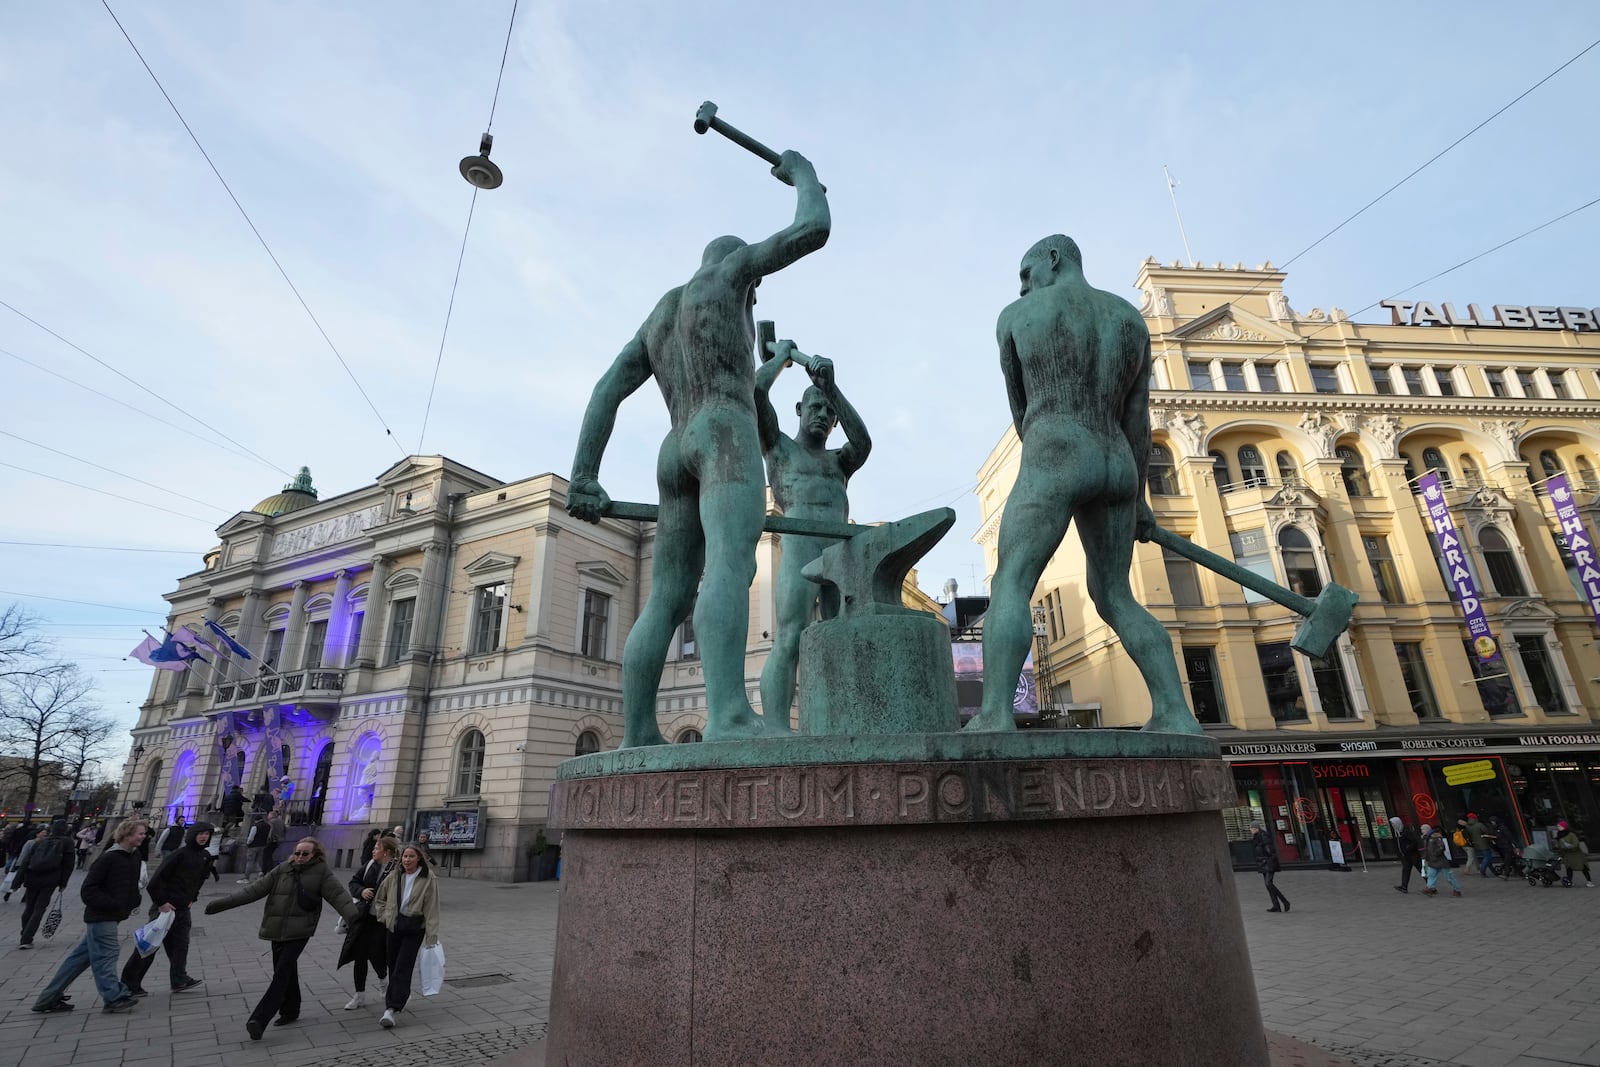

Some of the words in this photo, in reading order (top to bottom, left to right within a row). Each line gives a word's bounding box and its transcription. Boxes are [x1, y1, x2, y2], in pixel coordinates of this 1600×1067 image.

[1380, 300, 1600, 330] TALLBER
[1434, 515, 1479, 615] HARALD
[1340, 741, 1378, 751] SYNSAM
[1401, 737, 1447, 749] ROBERT'S
[1449, 737, 1487, 748] COFFEE
[1519, 736, 1547, 746] KIILA
[1230, 744, 1268, 755] UNITED
[1270, 743, 1316, 753] BANKERS
[1313, 764, 1370, 778] SYNSAM
